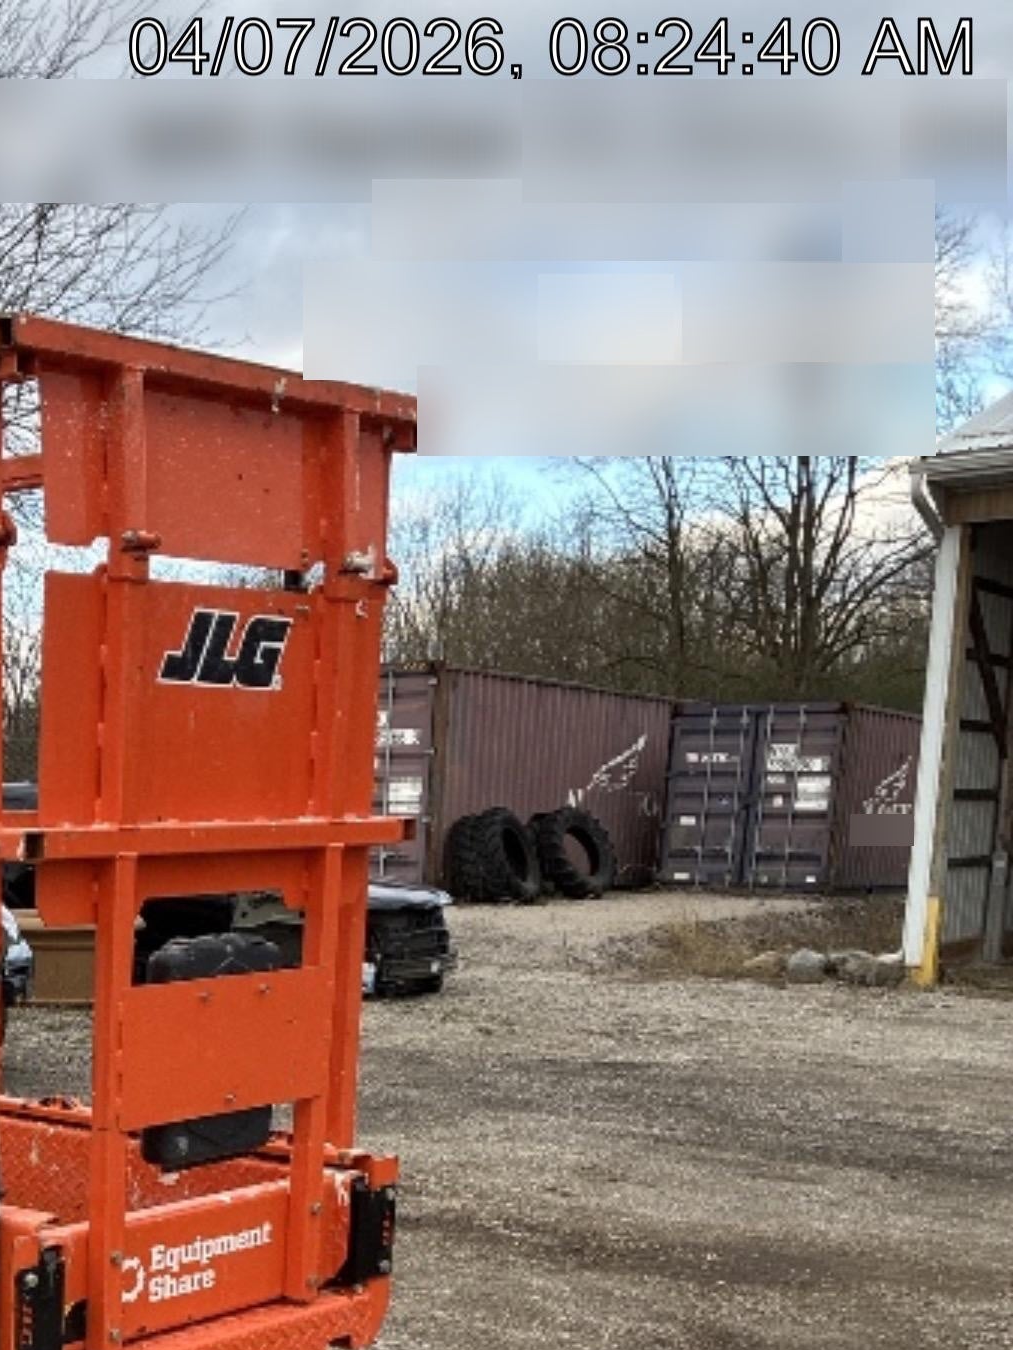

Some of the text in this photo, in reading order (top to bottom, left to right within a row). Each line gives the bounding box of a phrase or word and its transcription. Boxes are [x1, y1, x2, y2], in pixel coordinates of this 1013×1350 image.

[157, 607, 293, 690] JLG
[149, 1221, 273, 1273] Equipment
[148, 1267, 216, 1303] Share
